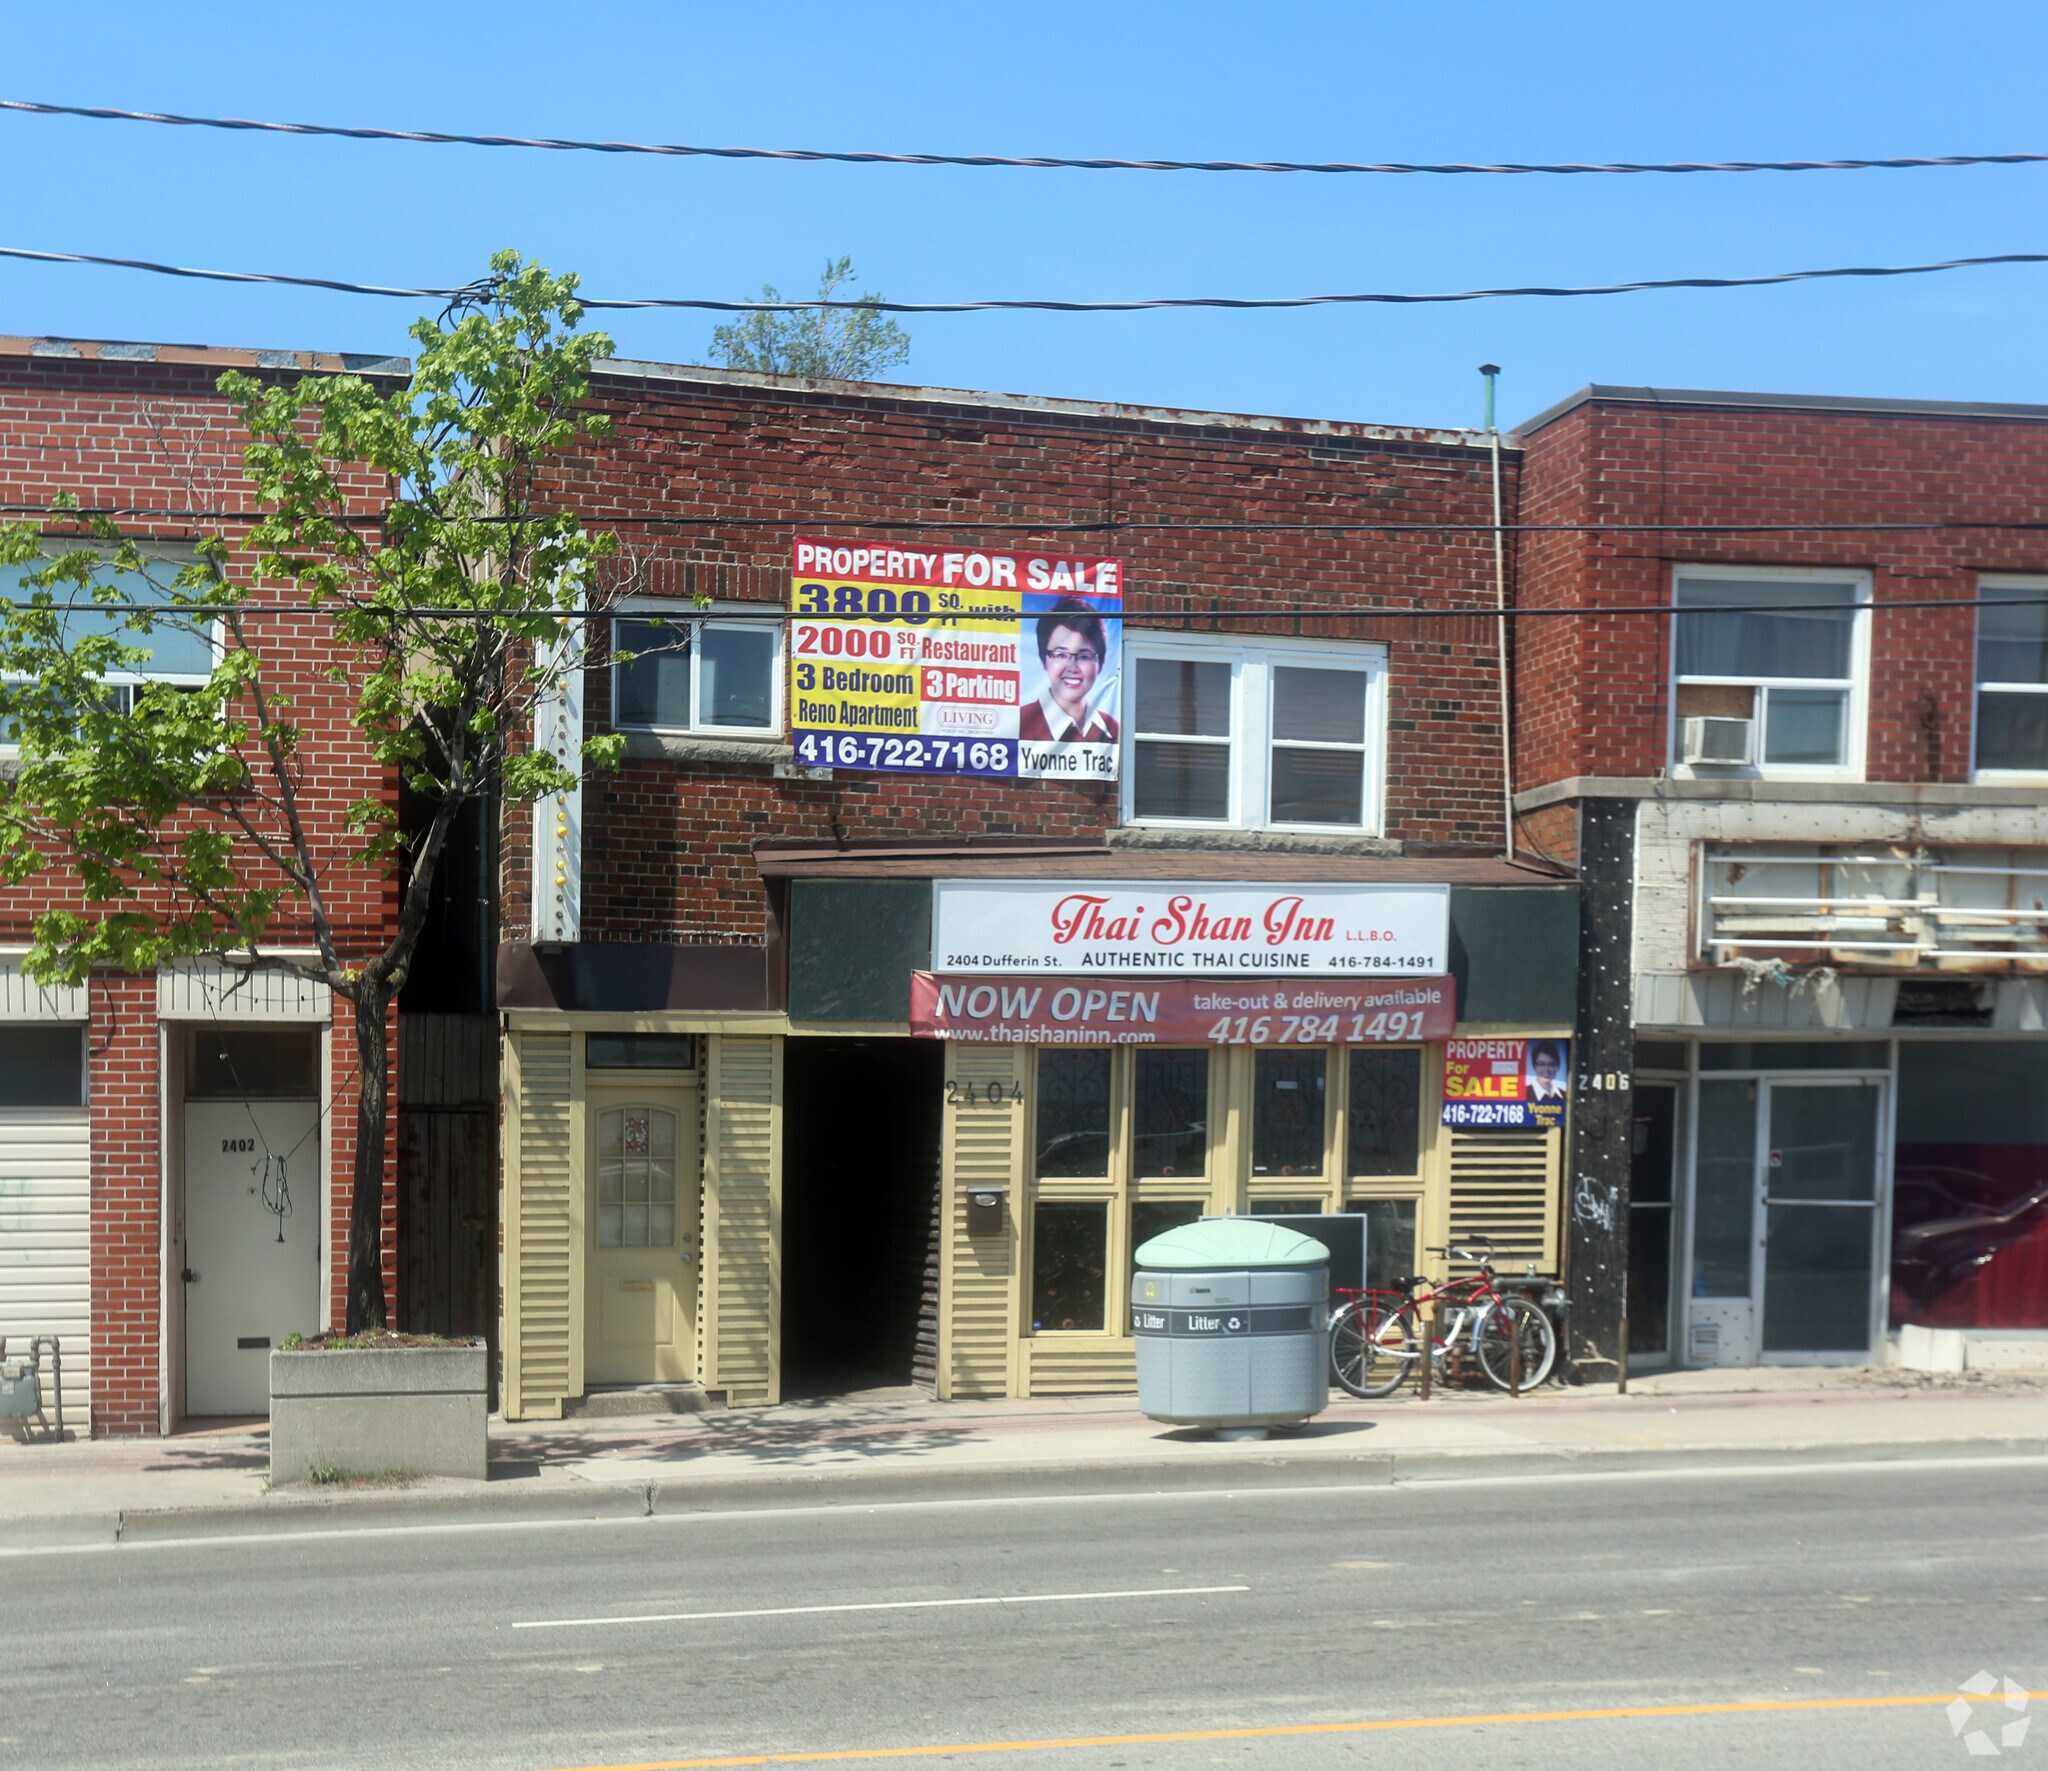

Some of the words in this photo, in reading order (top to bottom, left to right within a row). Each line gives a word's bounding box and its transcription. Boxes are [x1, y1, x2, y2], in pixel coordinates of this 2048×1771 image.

[797, 544, 937, 579] PROPERTY
[943, 553, 1017, 588] FOR
[1027, 559, 1118, 593] SALE
[799, 584, 931, 625] 3800
[797, 625, 891, 658] 2000
[922, 637, 1016, 664] Restaurant
[900, 647, 916, 660] FT
[797, 663, 816, 691] 3
[822, 667, 914, 694] Bedroom
[926, 670, 943, 697] 3
[946, 673, 1017, 702] Parking
[799, 698, 837, 724] Reno
[840, 701, 918, 728] Apartment
[943, 711, 993, 725] LIVING
[799, 734, 1009, 771] 416-722-7168
[1022, 748, 1077, 772] Yvonne
[1083, 750, 1114, 773] Trac
[1051, 894, 1145, 944] Thai
[1151, 896, 1252, 945] Shan
[1263, 896, 1335, 946] Inn
[1345, 930, 1397, 942] L.L.B.O.
[947, 954, 979, 966] 2404
[982, 954, 1039, 967] Dufferin
[1044, 955, 1062, 967] St.
[1081, 952, 1184, 967] AUTHENTIC
[1192, 952, 1233, 967] THAI
[1239, 953, 1310, 967] CUISINE
[1328, 956, 1434, 968] 416-784-1491
[933, 984, 1042, 1020] NOW
[1051, 987, 1160, 1023] OPEN
[1193, 992, 1269, 1011] take-out
[1273, 992, 1288, 1010] &
[1292, 991, 1361, 1011] delivery
[1364, 988, 1442, 1008] available
[933, 1023, 1156, 1043] www.thaishaninn.com
[1208, 1015, 1271, 1044] 416
[1278, 1014, 1339, 1043] 784
[1345, 1011, 1425, 1042] 1491
[1446, 1040, 1525, 1059] PROPERTY
[1446, 1061, 1470, 1075] For
[1445, 1076, 1519, 1097] SALE
[1579, 1073, 1630, 1091] 2406
[946, 1080, 1024, 1105] 2404
[1443, 1103, 1524, 1124] 416-722-7168
[1527, 1102, 1562, 1115] Yvonne
[1535, 1114, 1557, 1126] Trac
[222, 1138, 255, 1153] 2402
[1143, 1313, 1165, 1329] Litter
[1188, 1315, 1221, 1331] Litter
